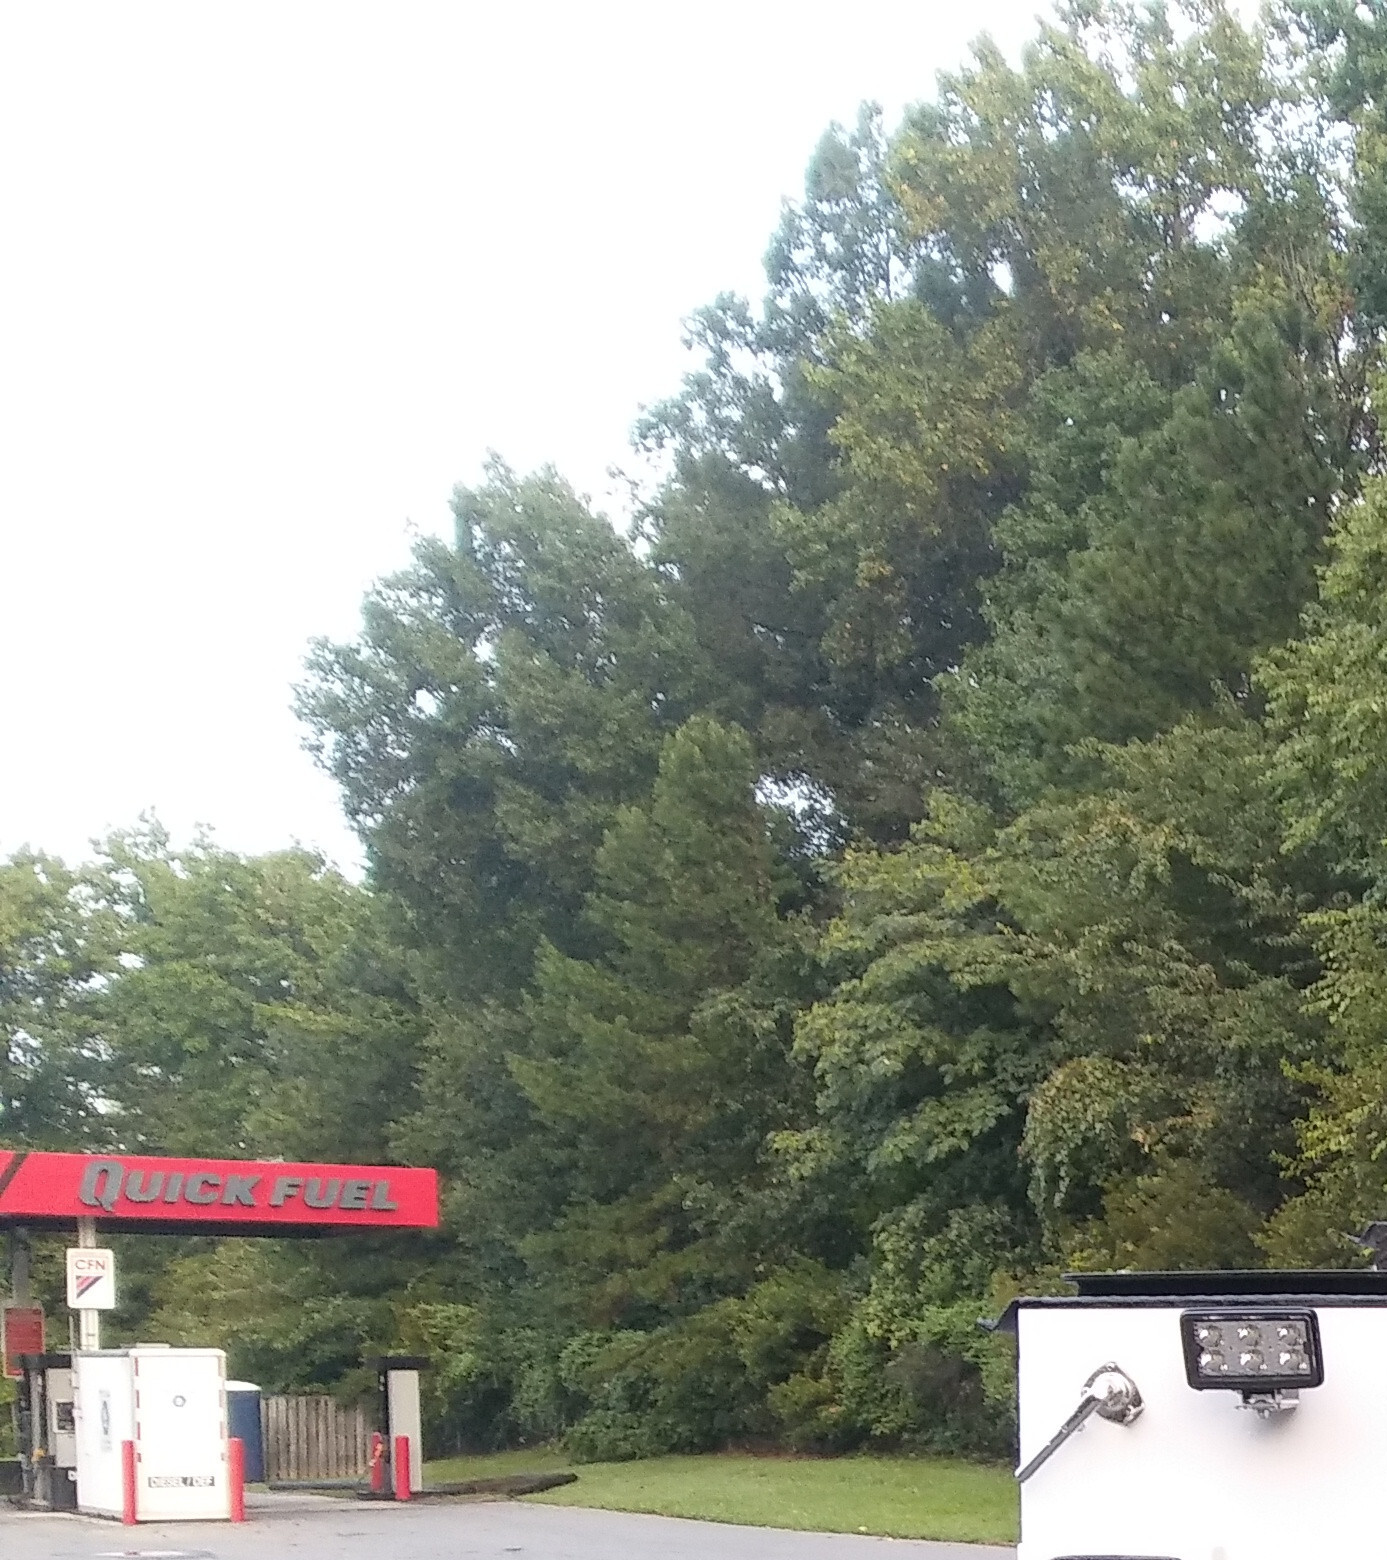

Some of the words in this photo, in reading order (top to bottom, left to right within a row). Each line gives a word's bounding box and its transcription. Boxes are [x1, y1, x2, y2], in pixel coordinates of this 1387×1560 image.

[79, 1160, 262, 1212] QUICK
[268, 1176, 398, 1211] FUEL
[75, 1259, 105, 1271] CFN
[150, 1476, 185, 1488] DIESEL
